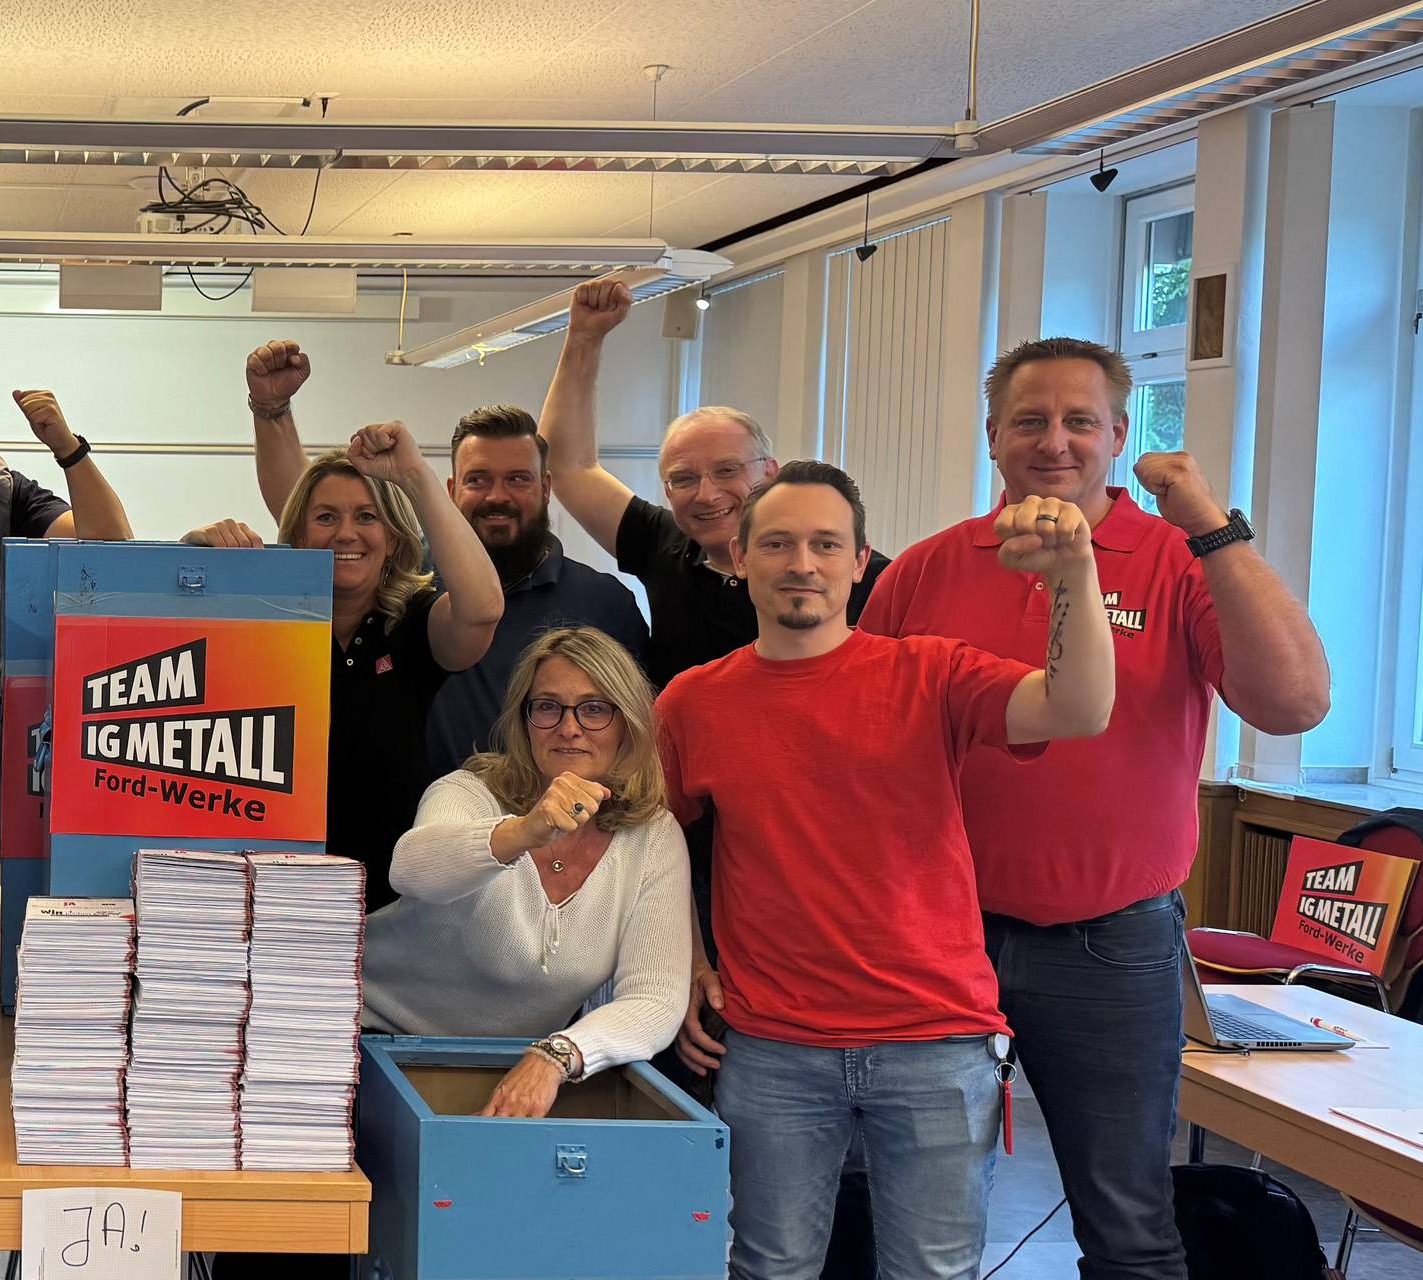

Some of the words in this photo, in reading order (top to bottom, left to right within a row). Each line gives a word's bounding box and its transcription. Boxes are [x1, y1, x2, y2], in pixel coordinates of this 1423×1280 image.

[87, 650, 197, 709] TEAM
[87, 725, 120, 759] IG
[126, 715, 285, 785] METALL
[94, 768, 266, 822] Ford-Werke
[1305, 865, 1356, 892] TEAM
[1298, 920, 1365, 963] Ford-Werke
[1299, 896, 1316, 917] IG
[1315, 899, 1382, 946] METALL
[61, 1202, 147, 1267] JA!
